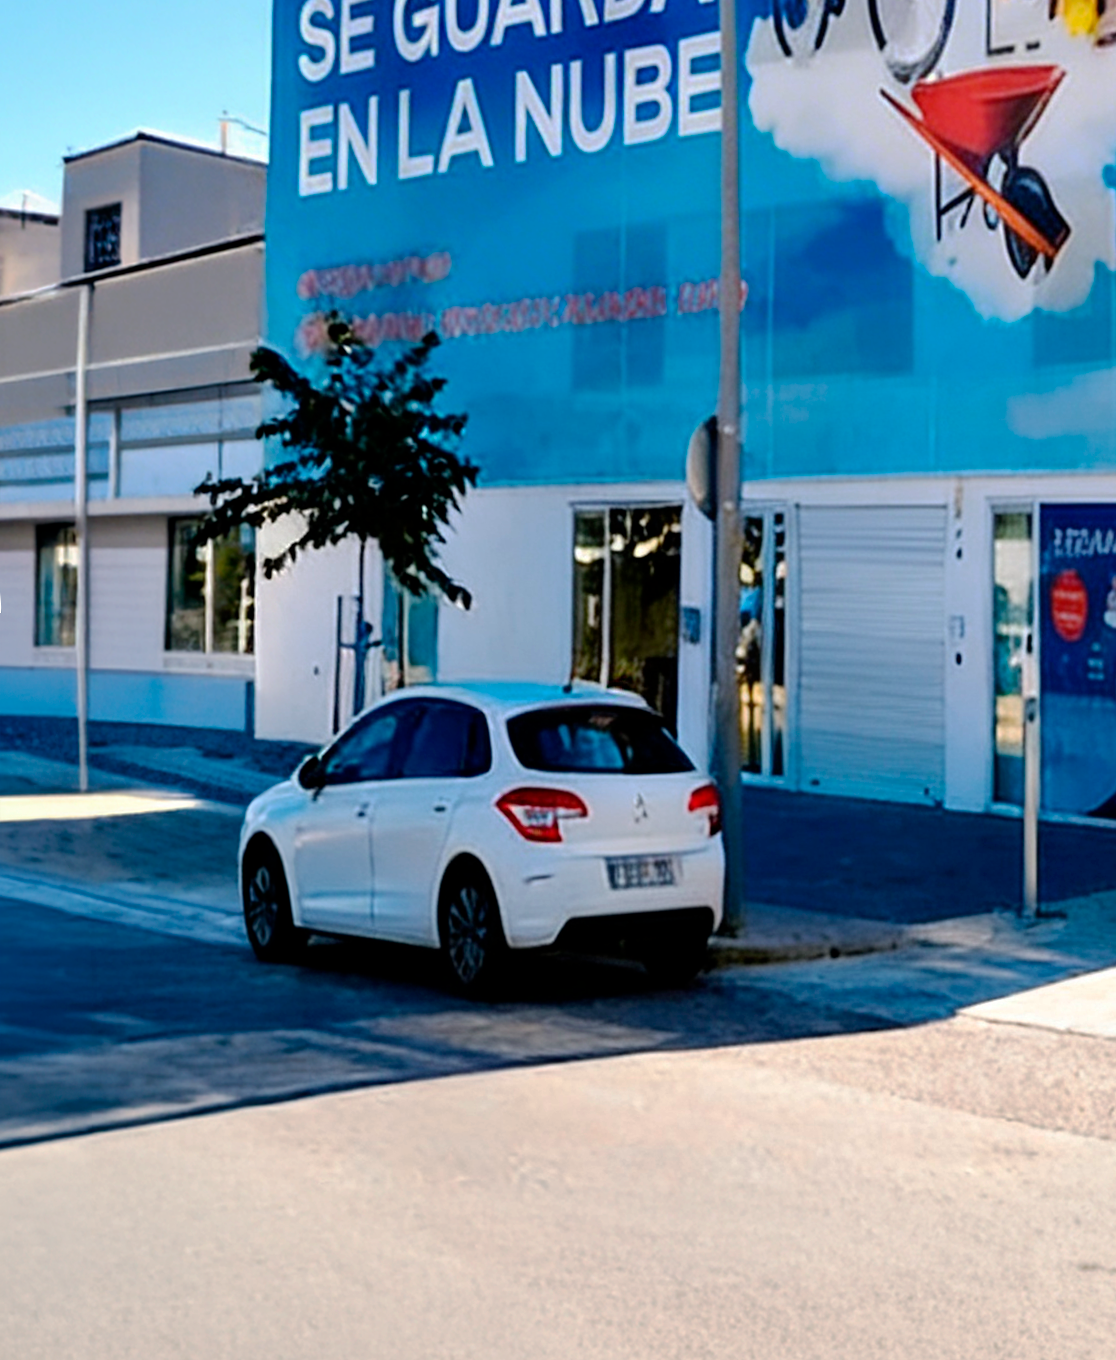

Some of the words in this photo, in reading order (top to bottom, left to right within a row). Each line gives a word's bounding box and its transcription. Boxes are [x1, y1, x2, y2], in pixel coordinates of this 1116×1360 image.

[299, 95, 379, 197] EN
[398, 78, 495, 180] LA
[515, 31, 723, 164] NUBE
